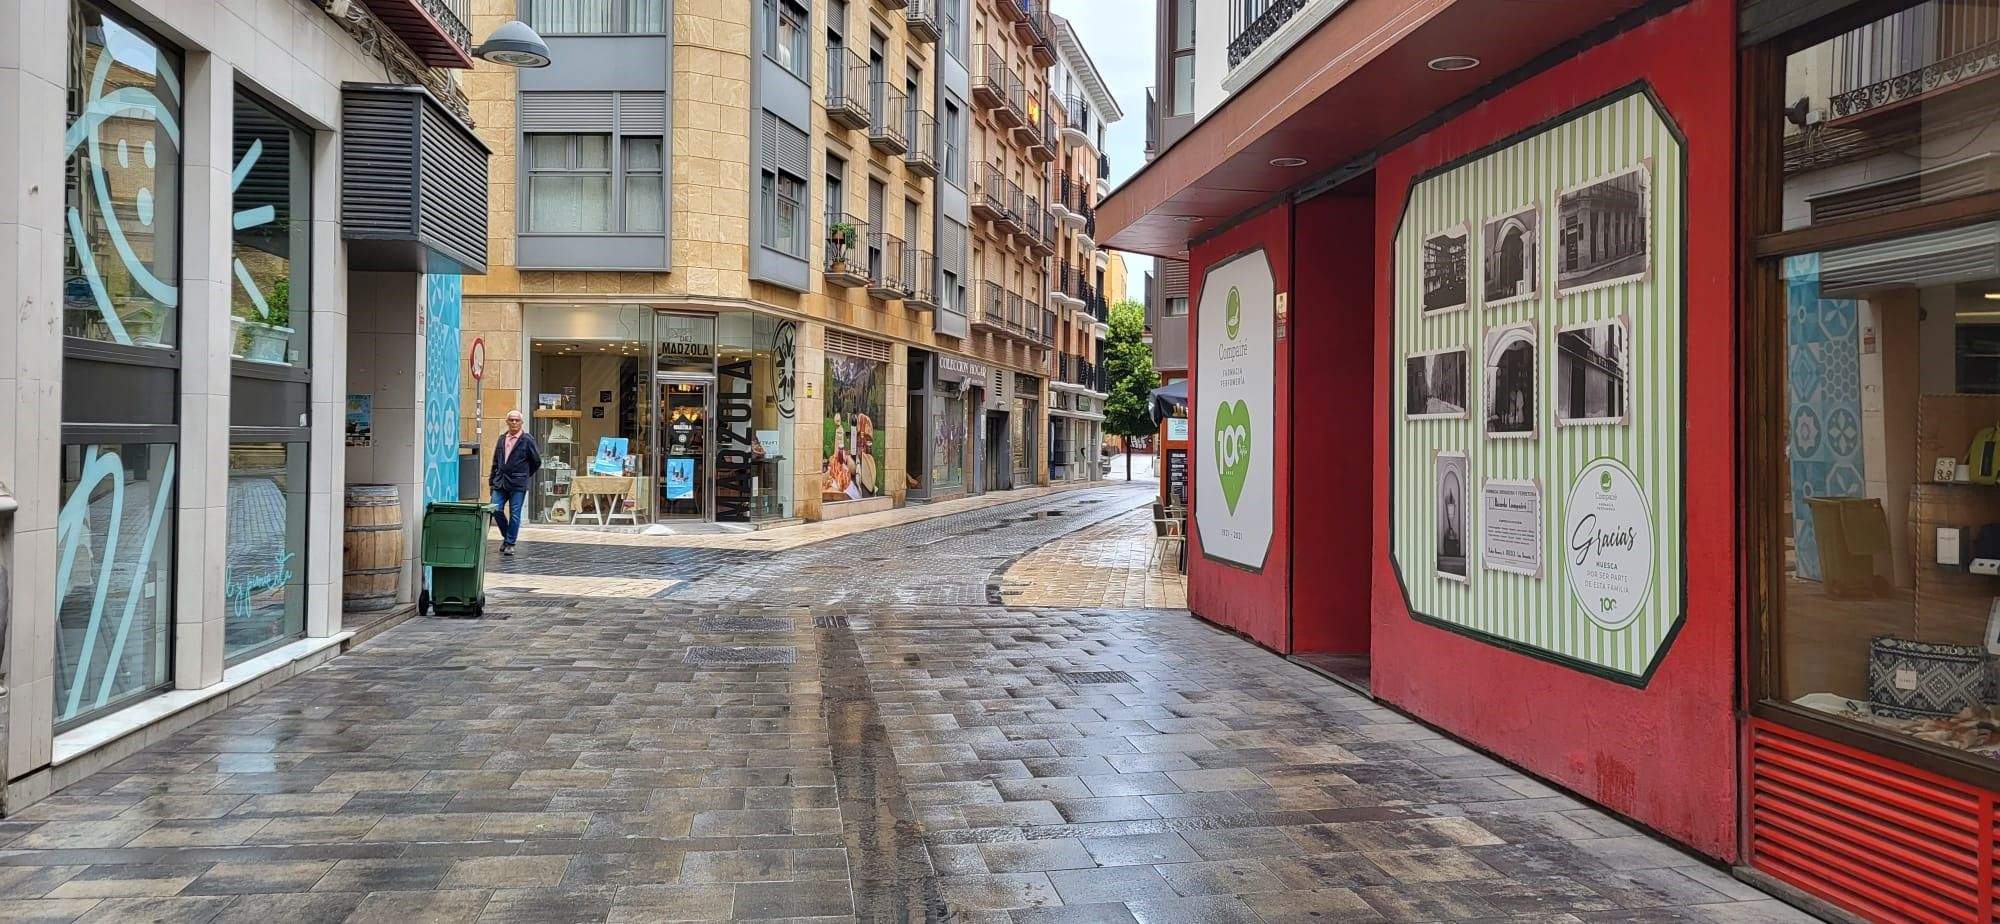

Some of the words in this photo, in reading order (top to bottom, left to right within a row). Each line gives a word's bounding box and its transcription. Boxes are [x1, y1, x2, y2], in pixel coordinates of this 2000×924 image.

[662, 342, 708, 356] MARZOLA
[1219, 337, 1248, 362] Compairé
[716, 359, 752, 522] MARZOLA
[1571, 513, 1637, 566] Gracias
[1596, 561, 1618, 570] HUESCA
[1586, 570, 1598, 578] POR
[1598, 571, 1610, 579] SER
[1610, 573, 1628, 583] PARTE
[1584, 580, 1593, 588] DE
[1593, 581, 1606, 590] ESTA
